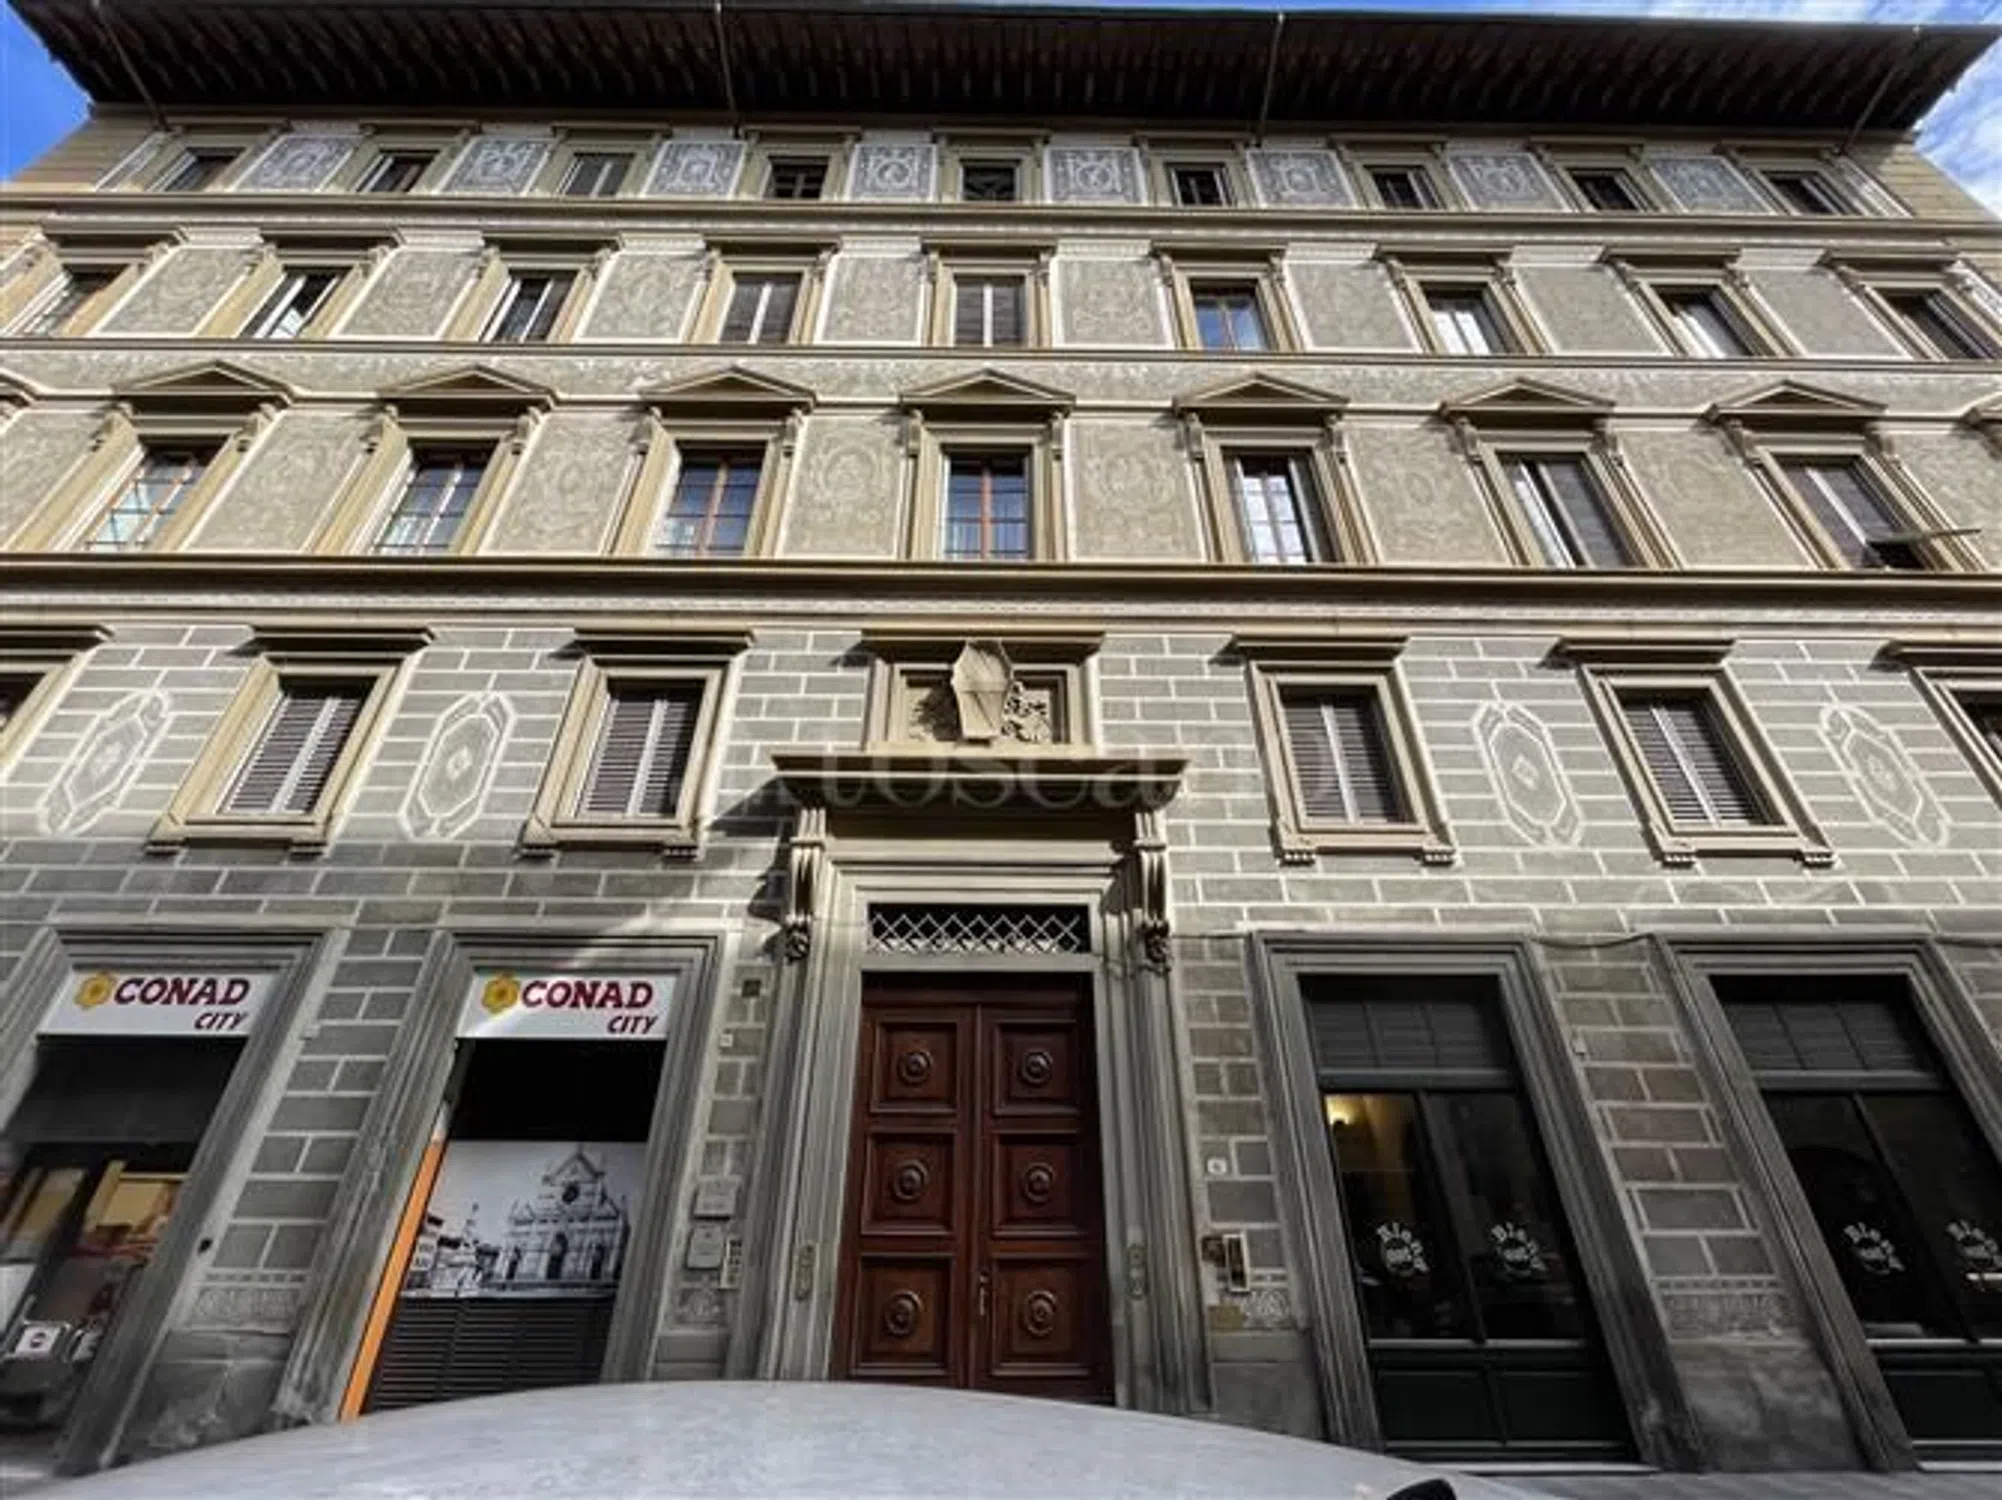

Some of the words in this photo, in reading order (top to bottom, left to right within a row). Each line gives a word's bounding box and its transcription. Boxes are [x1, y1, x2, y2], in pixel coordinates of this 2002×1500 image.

[114, 976, 250, 1006] CONAD
[521, 979, 654, 1008] CONAD
[194, 1012, 248, 1030] CITY
[606, 1015, 659, 1034] CITY
